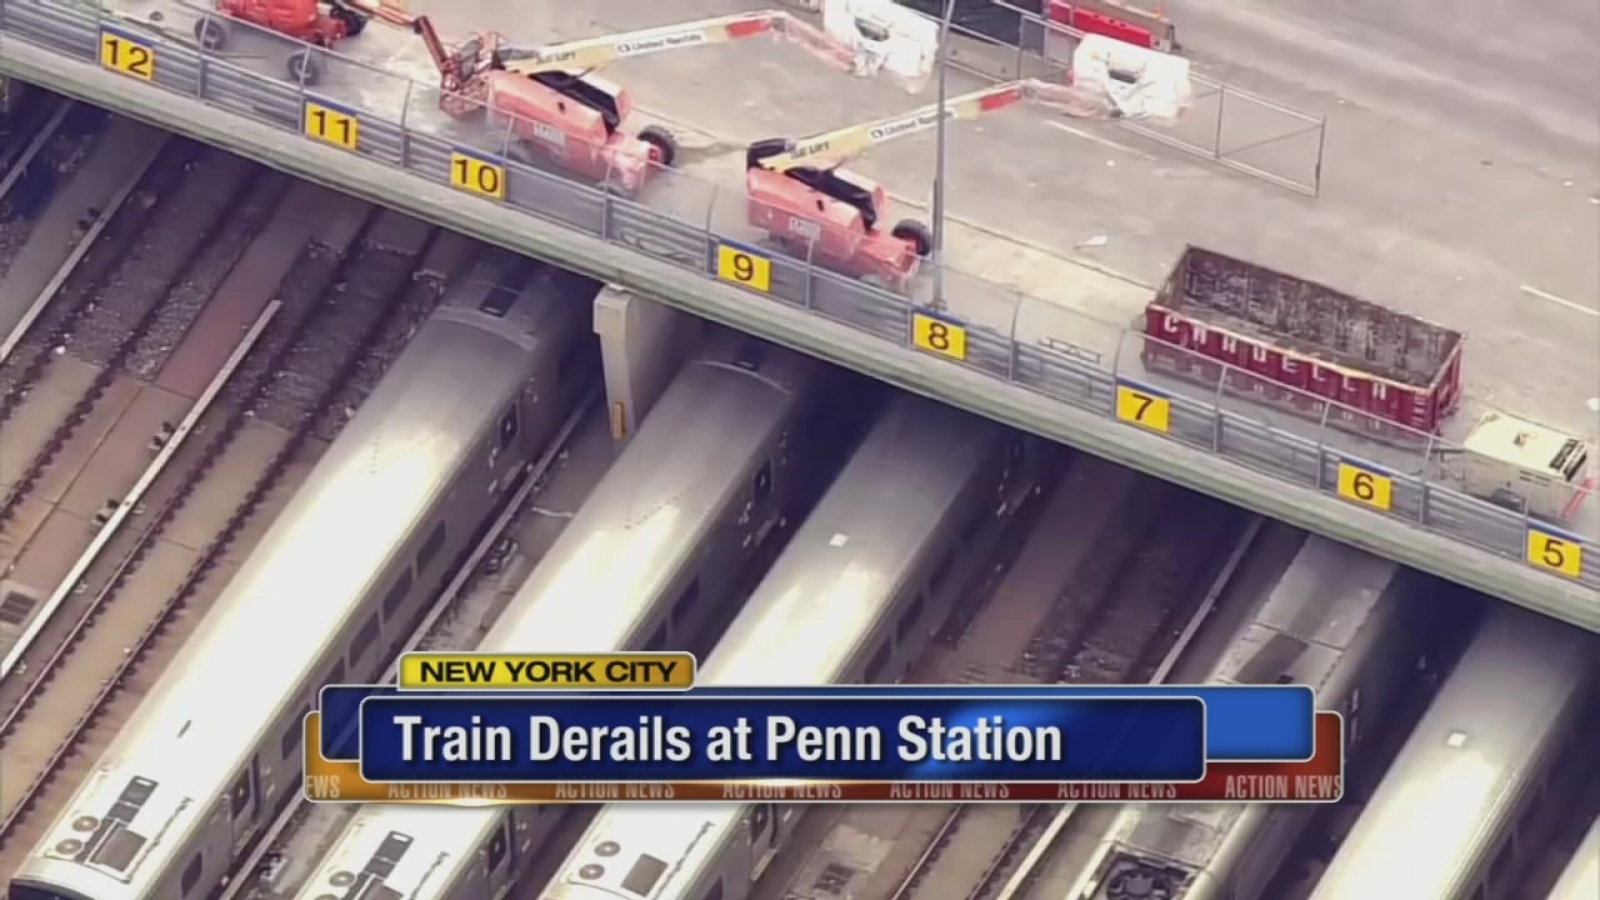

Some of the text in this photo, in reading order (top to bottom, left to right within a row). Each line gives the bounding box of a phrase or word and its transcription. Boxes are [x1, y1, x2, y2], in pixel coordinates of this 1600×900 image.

[105, 38, 149, 76] 12
[310, 110, 350, 145] 11
[454, 158, 499, 193] 10
[733, 253, 754, 282] 9
[927, 322, 950, 351] 8
[1132, 392, 1154, 421] 7
[1353, 472, 1375, 501] 6
[1543, 538, 1565, 568] 5
